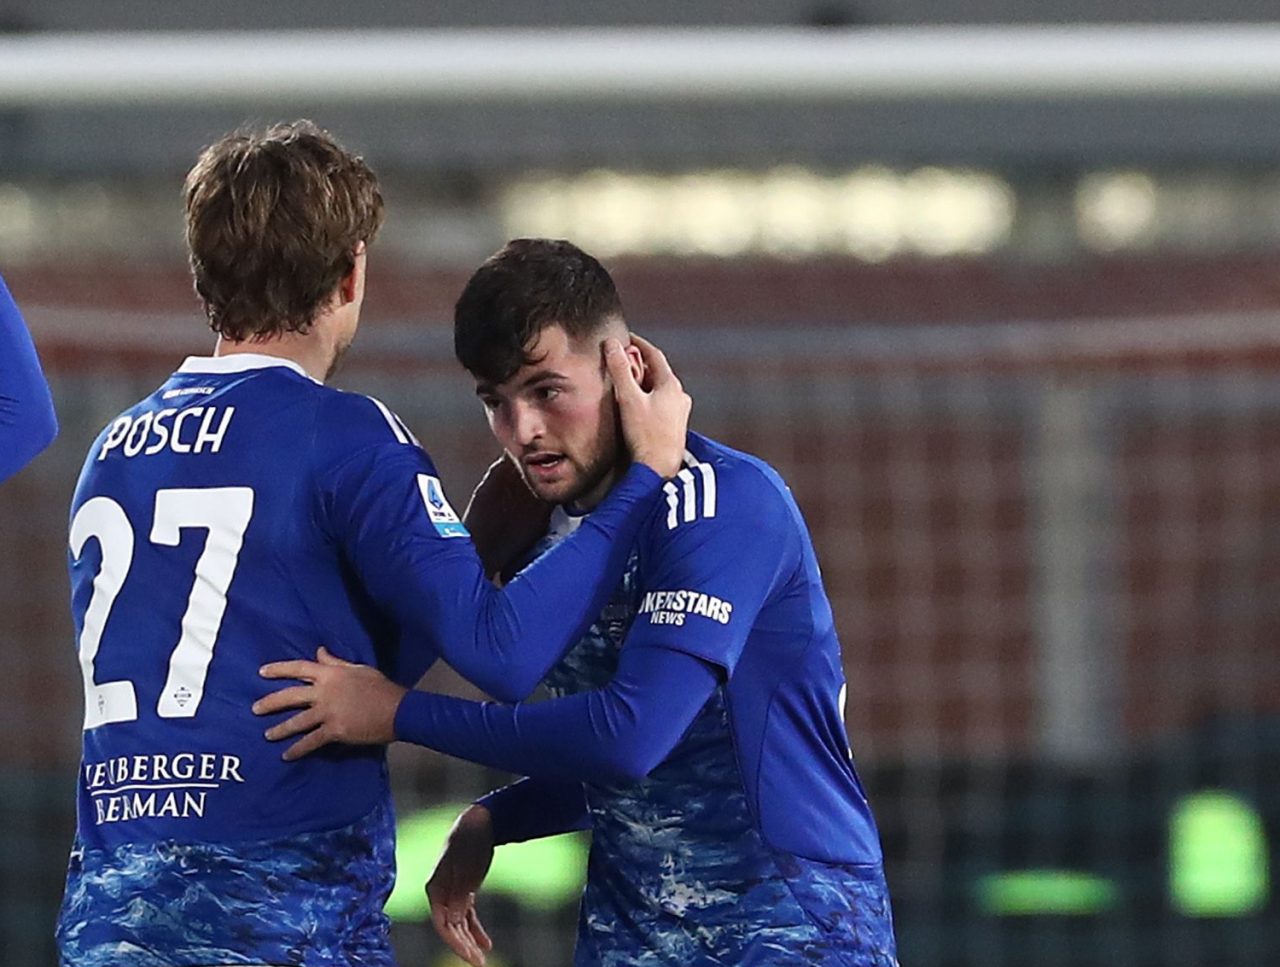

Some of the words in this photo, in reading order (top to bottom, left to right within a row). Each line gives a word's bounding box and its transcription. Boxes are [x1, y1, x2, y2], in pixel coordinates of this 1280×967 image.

[98, 406, 235, 461] POSCH
[68, 487, 254, 730] 27
[650, 611, 686, 626] NEWS
